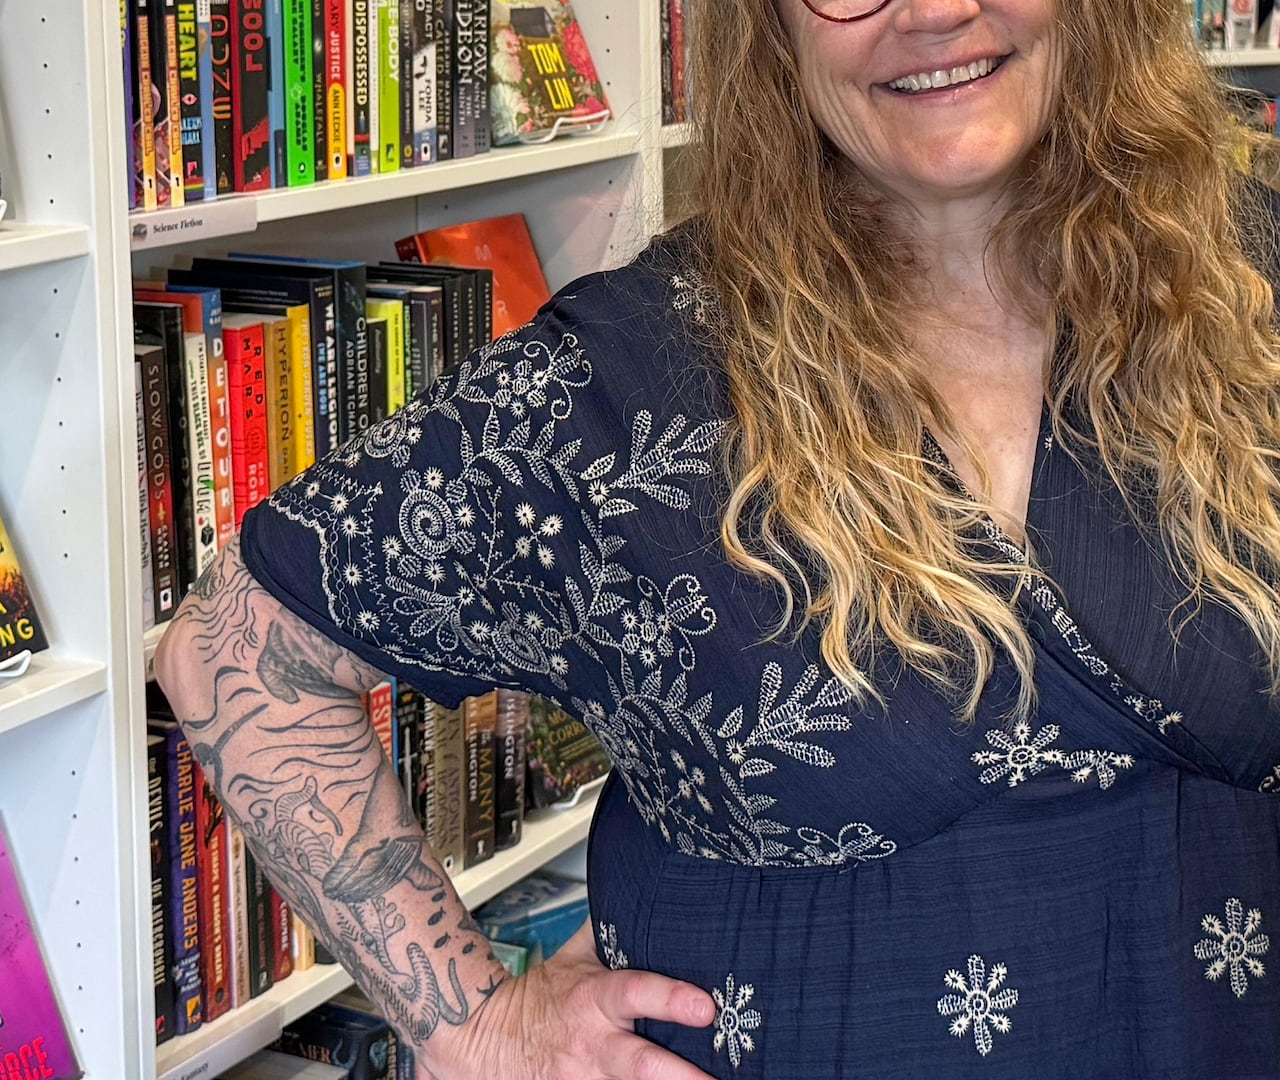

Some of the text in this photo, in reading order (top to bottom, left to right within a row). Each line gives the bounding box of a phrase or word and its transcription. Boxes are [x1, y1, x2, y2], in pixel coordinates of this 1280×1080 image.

[178, 2, 198, 82] HEART
[356, 0, 368, 107] DISPOSSESSED
[529, 42, 564, 77] TOM
[544, 77, 574, 111] LIN
[152, 217, 204, 234] Science Fiction
[213, 338, 230, 508] DETOUR
[274, 327, 289, 444] HYPERION
[479, 747, 494, 821] MANY
[176, 741, 198, 952] CHARLIE JANE ANDERS
